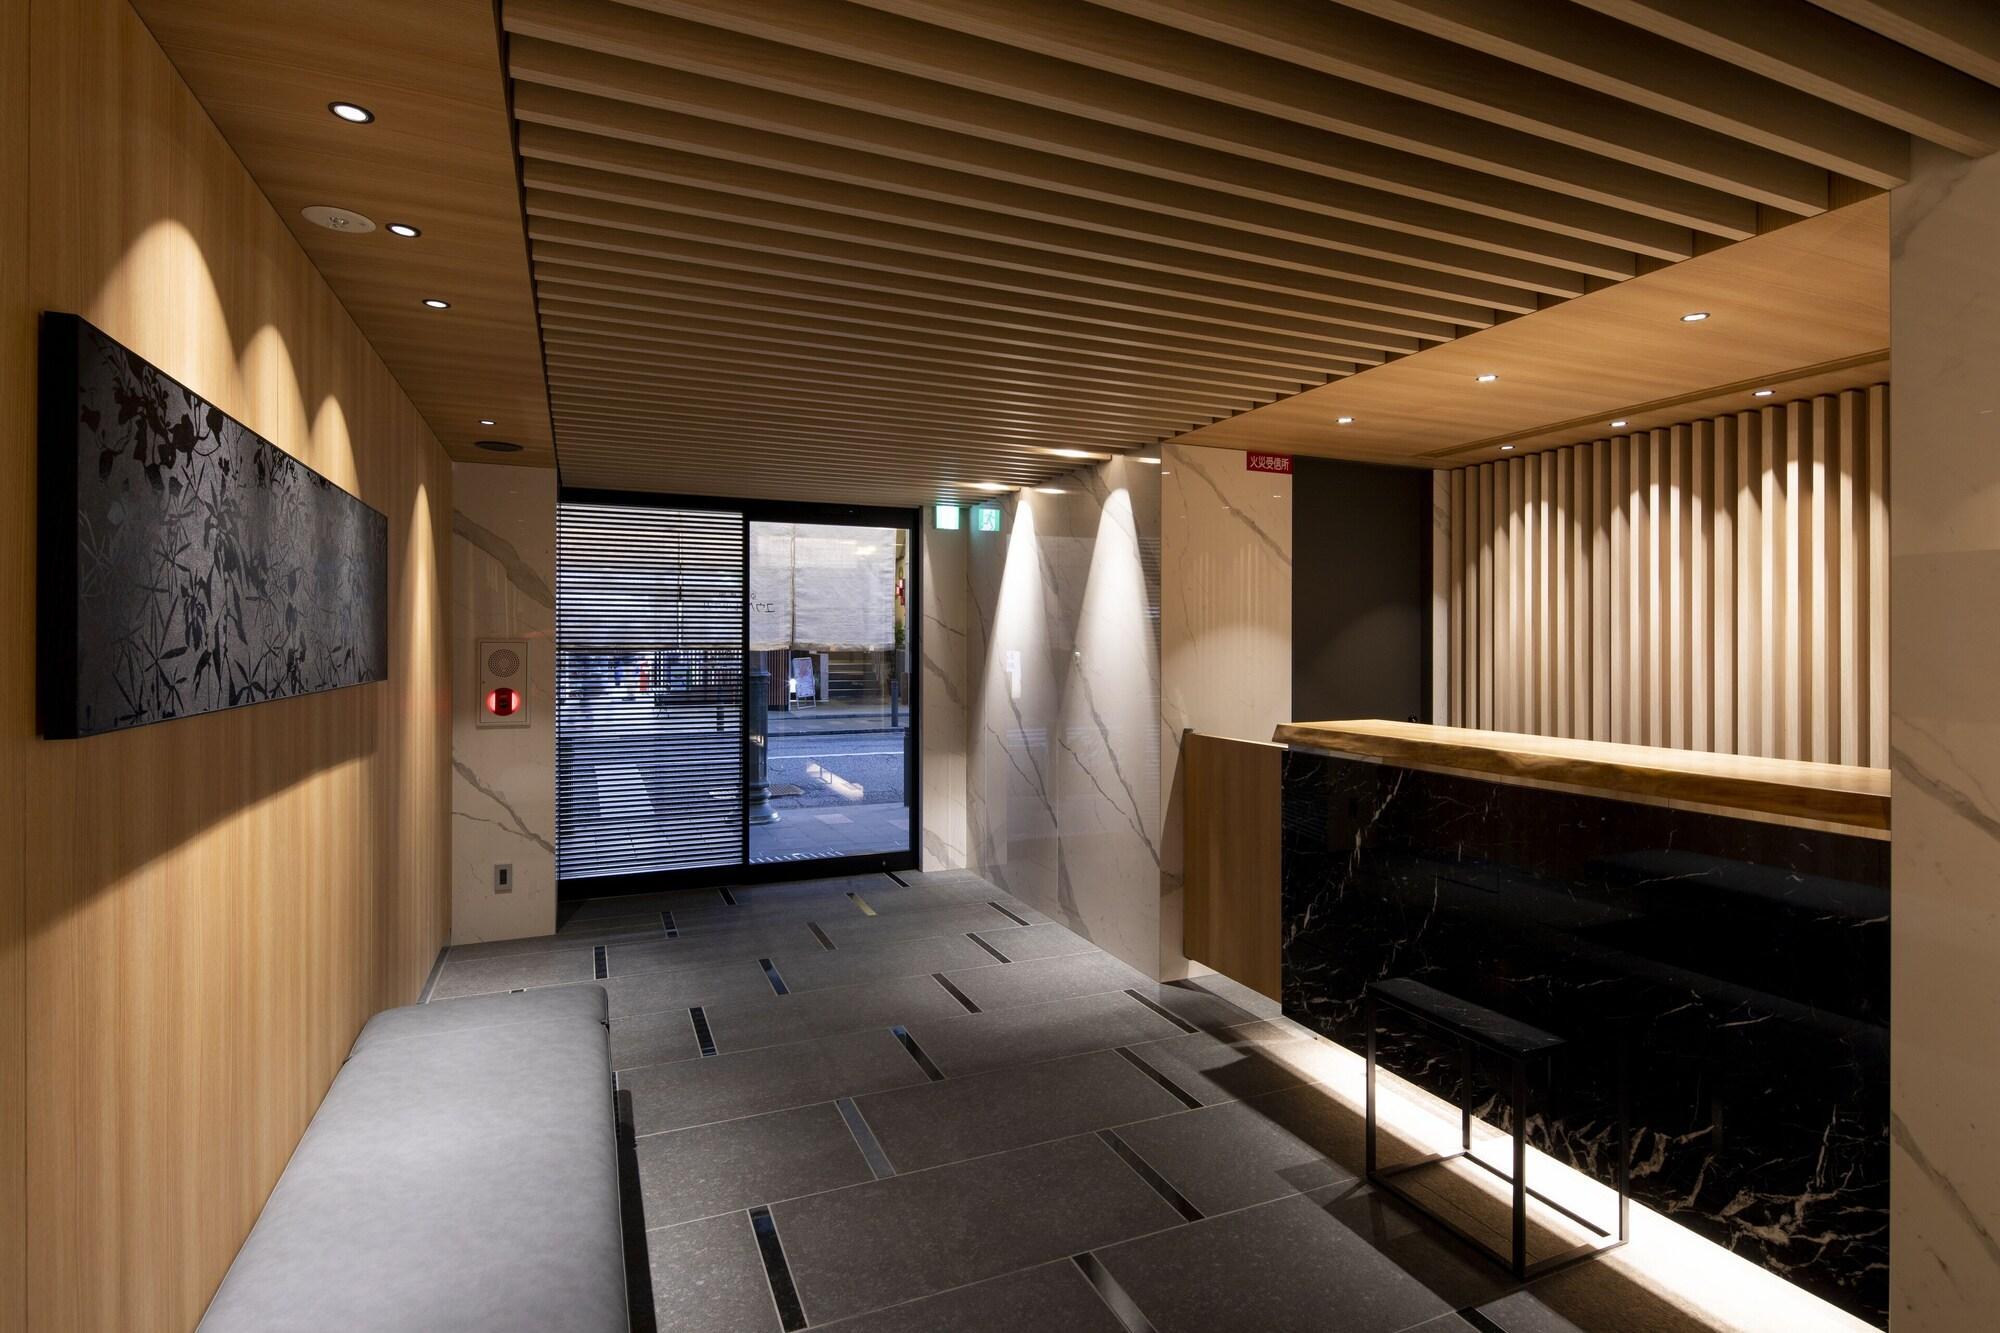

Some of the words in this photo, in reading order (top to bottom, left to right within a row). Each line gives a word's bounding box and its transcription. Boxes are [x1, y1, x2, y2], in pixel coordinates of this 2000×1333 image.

[1250, 455, 1289, 471] 火災受信所
